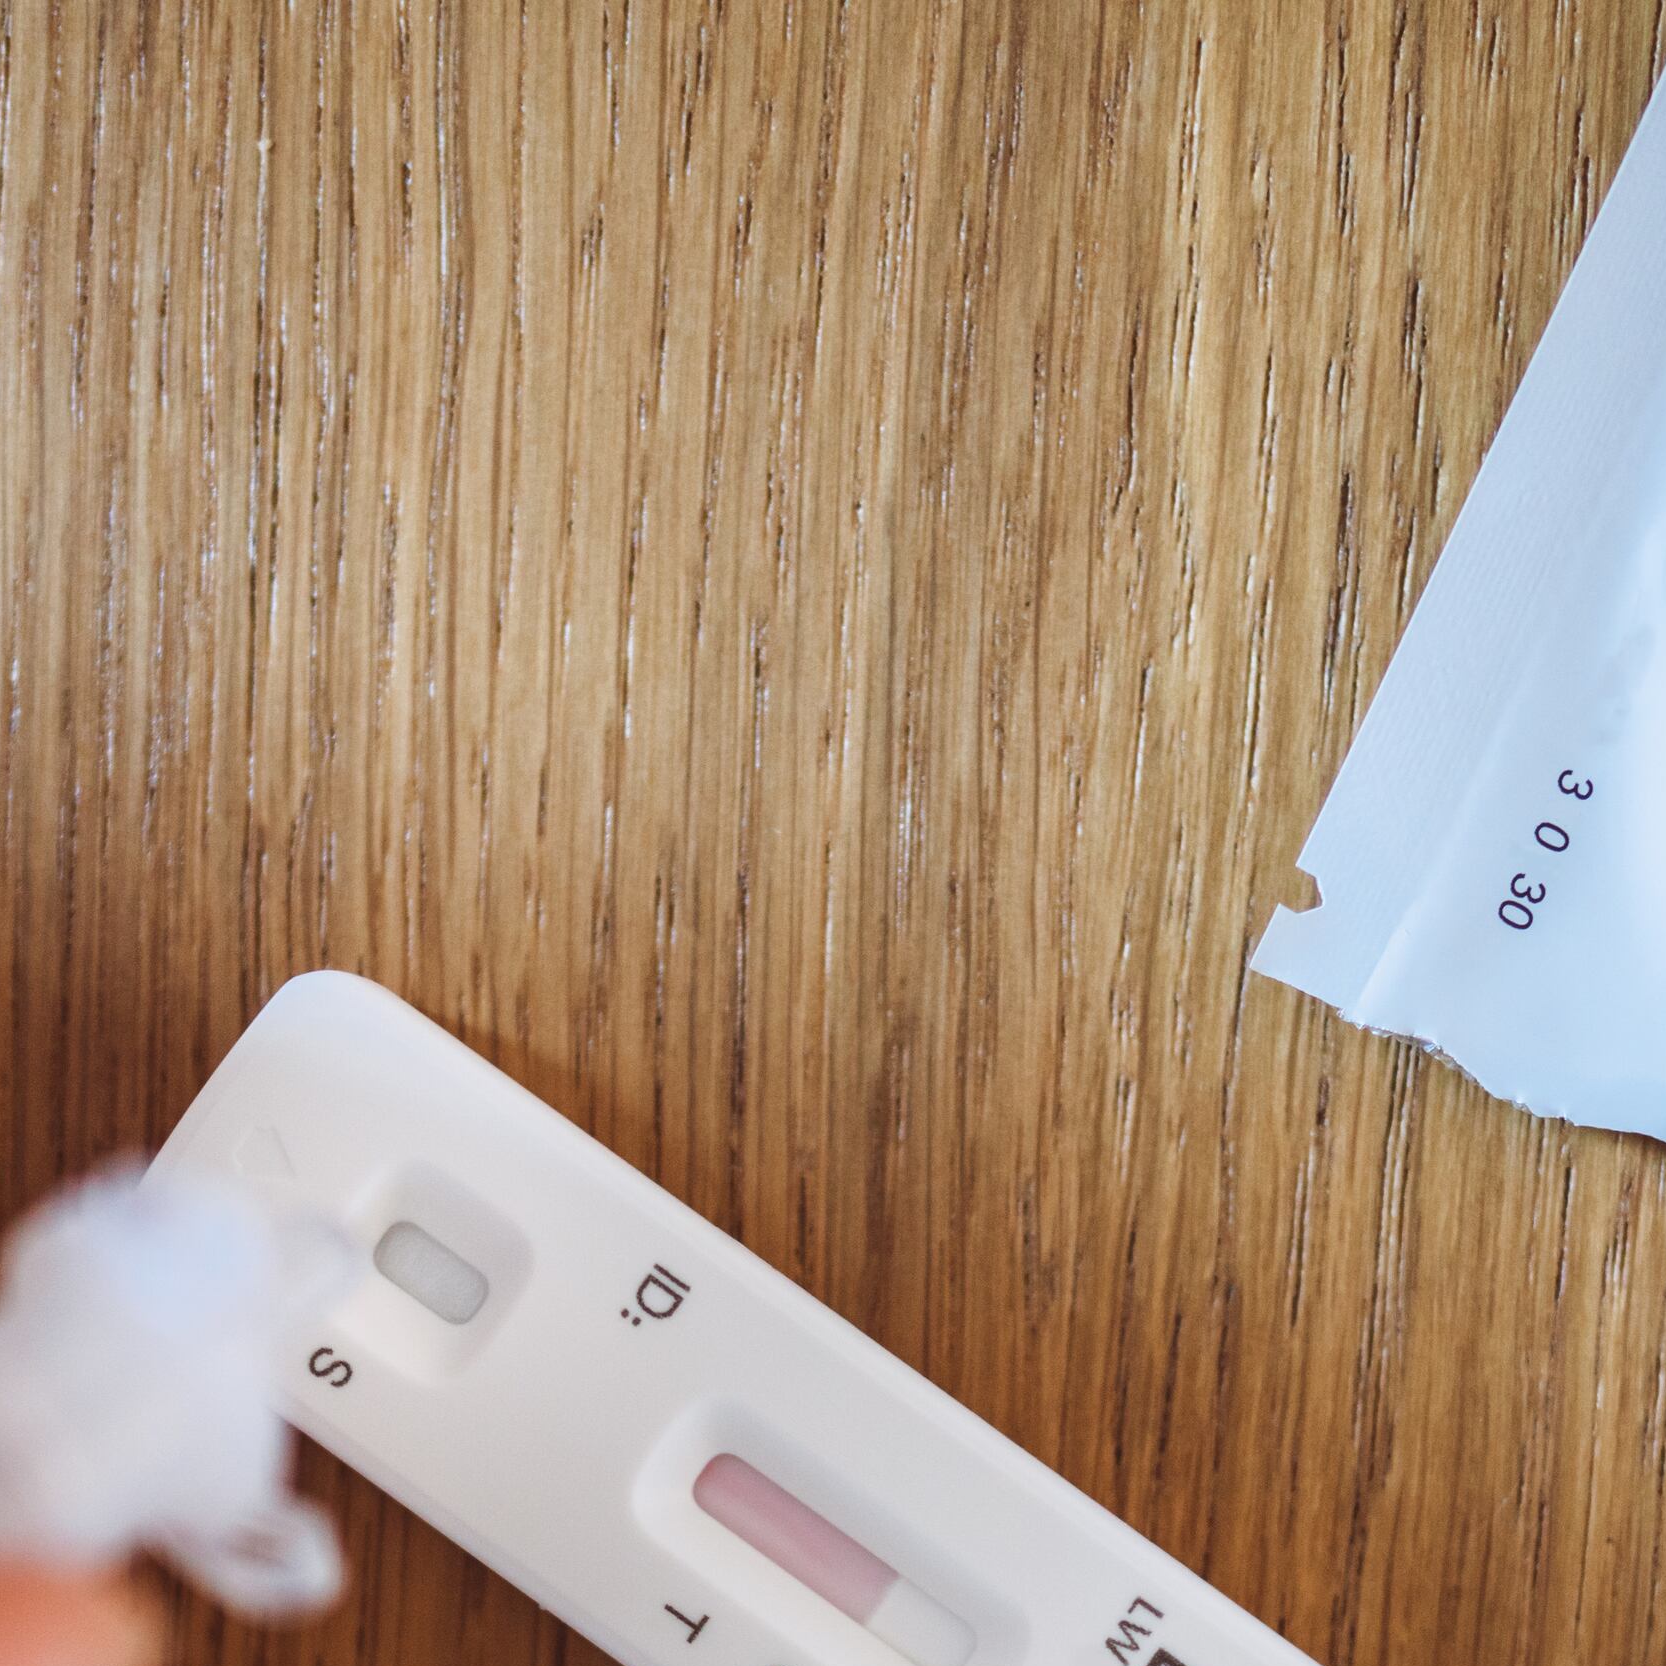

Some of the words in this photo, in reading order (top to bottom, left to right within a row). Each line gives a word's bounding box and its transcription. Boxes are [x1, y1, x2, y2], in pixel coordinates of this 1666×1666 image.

[1557, 769, 1594, 801] 3
[1497, 872, 1547, 931] 30
[620, 1263, 691, 1327] ID:
[307, 1346, 354, 1389] S
[663, 1603, 710, 1645] T
